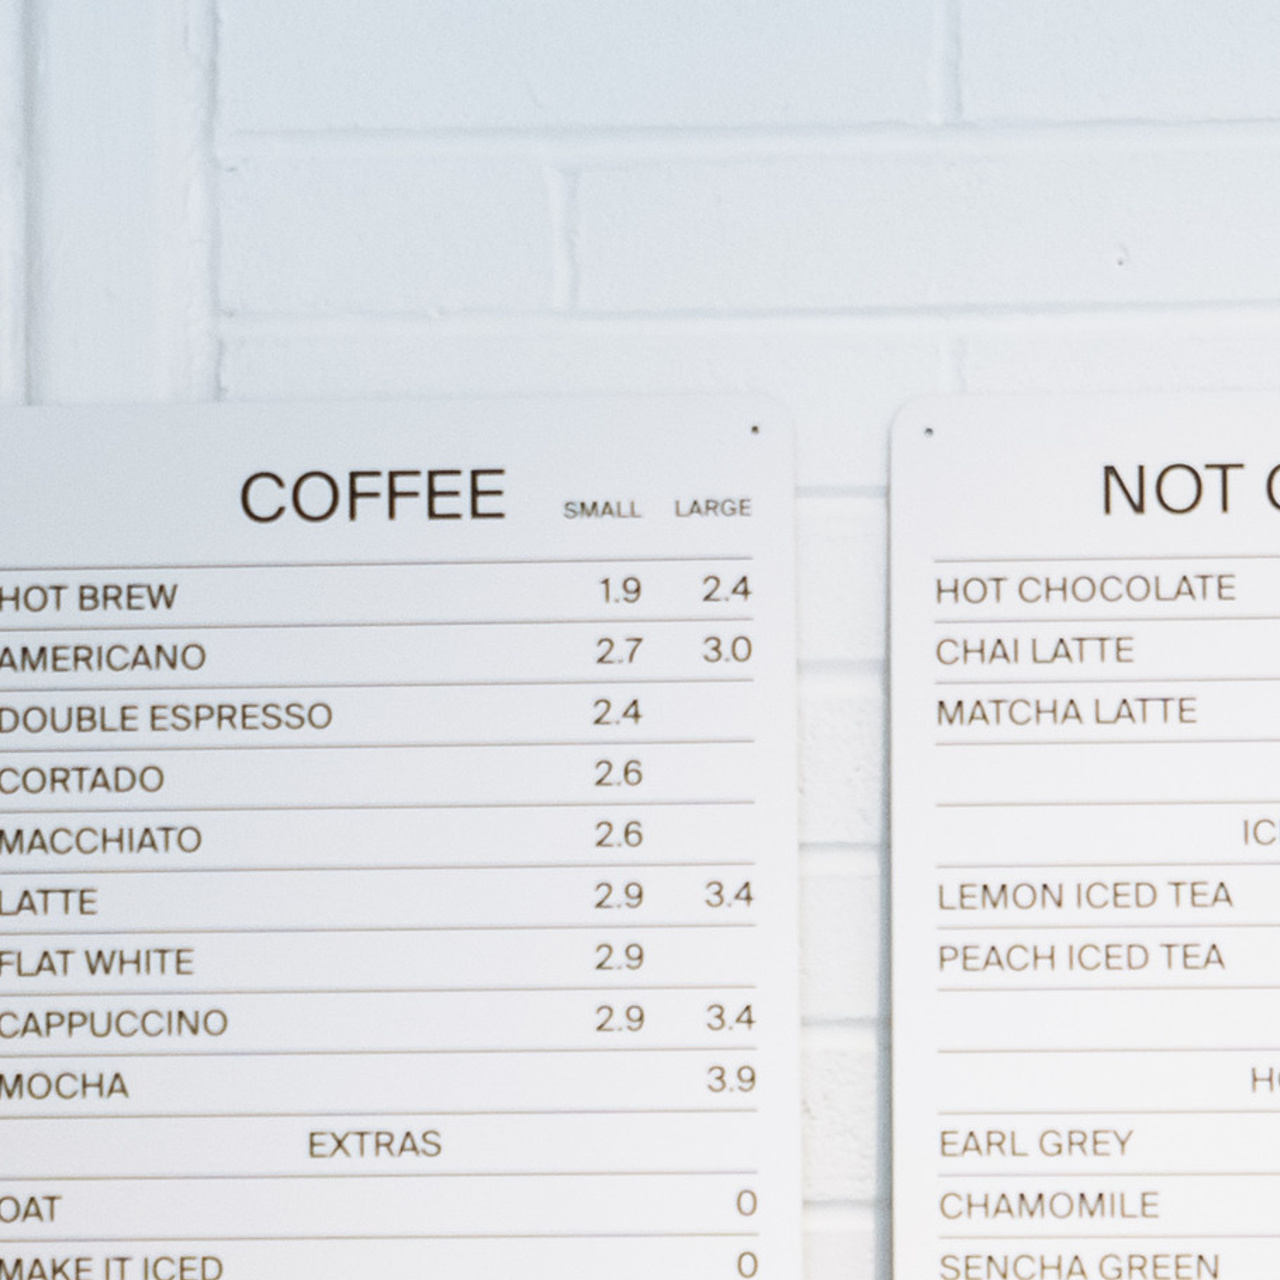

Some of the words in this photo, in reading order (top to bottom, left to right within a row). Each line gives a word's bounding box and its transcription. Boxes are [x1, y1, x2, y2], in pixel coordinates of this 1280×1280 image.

[240, 468, 506, 524] COFFEE
[1103, 463, 1245, 516] NOT
[564, 500, 644, 519] SMALL
[674, 498, 751, 518] LARGE
[78, 583, 178, 612] BREW
[600, 576, 642, 604] 1.9
[702, 575, 752, 602] 2.4
[936, 576, 1008, 605] HOT
[1017, 573, 1236, 604] CHOCOLATE
[596, 637, 644, 665] 2.7
[703, 635, 753, 663] 3.0
[935, 638, 1019, 665] CHAI
[1031, 636, 1134, 664] LATTE
[150, 702, 333, 732] ESPRESSO
[593, 698, 642, 726] 2.4
[937, 698, 1083, 726] MATCHA
[1094, 697, 1197, 725] LATTE
[594, 759, 643, 787] 2.6
[595, 820, 644, 848] 2.6
[594, 881, 644, 909] 2.9
[705, 880, 754, 908] 3.4
[938, 883, 1063, 910] LEMON
[1076, 881, 1158, 909] ICED
[1168, 881, 1233, 908] TEA
[84, 948, 194, 976] WHITE
[595, 943, 644, 971] 2.9
[939, 944, 1055, 972] PEACH
[1068, 943, 1150, 972] ICED
[1160, 943, 1225, 970] TEA
[595, 1004, 645, 1032] 2.9
[707, 1003, 756, 1031] 3.4
[707, 1065, 757, 1093] 3.9
[308, 1129, 442, 1159] EXTRAS
[940, 1130, 1028, 1157] EARL
[1038, 1129, 1134, 1157] GREY
[939, 1191, 1159, 1220] CHAMOMILE
[1098, 1253, 1219, 1280] GREEN
